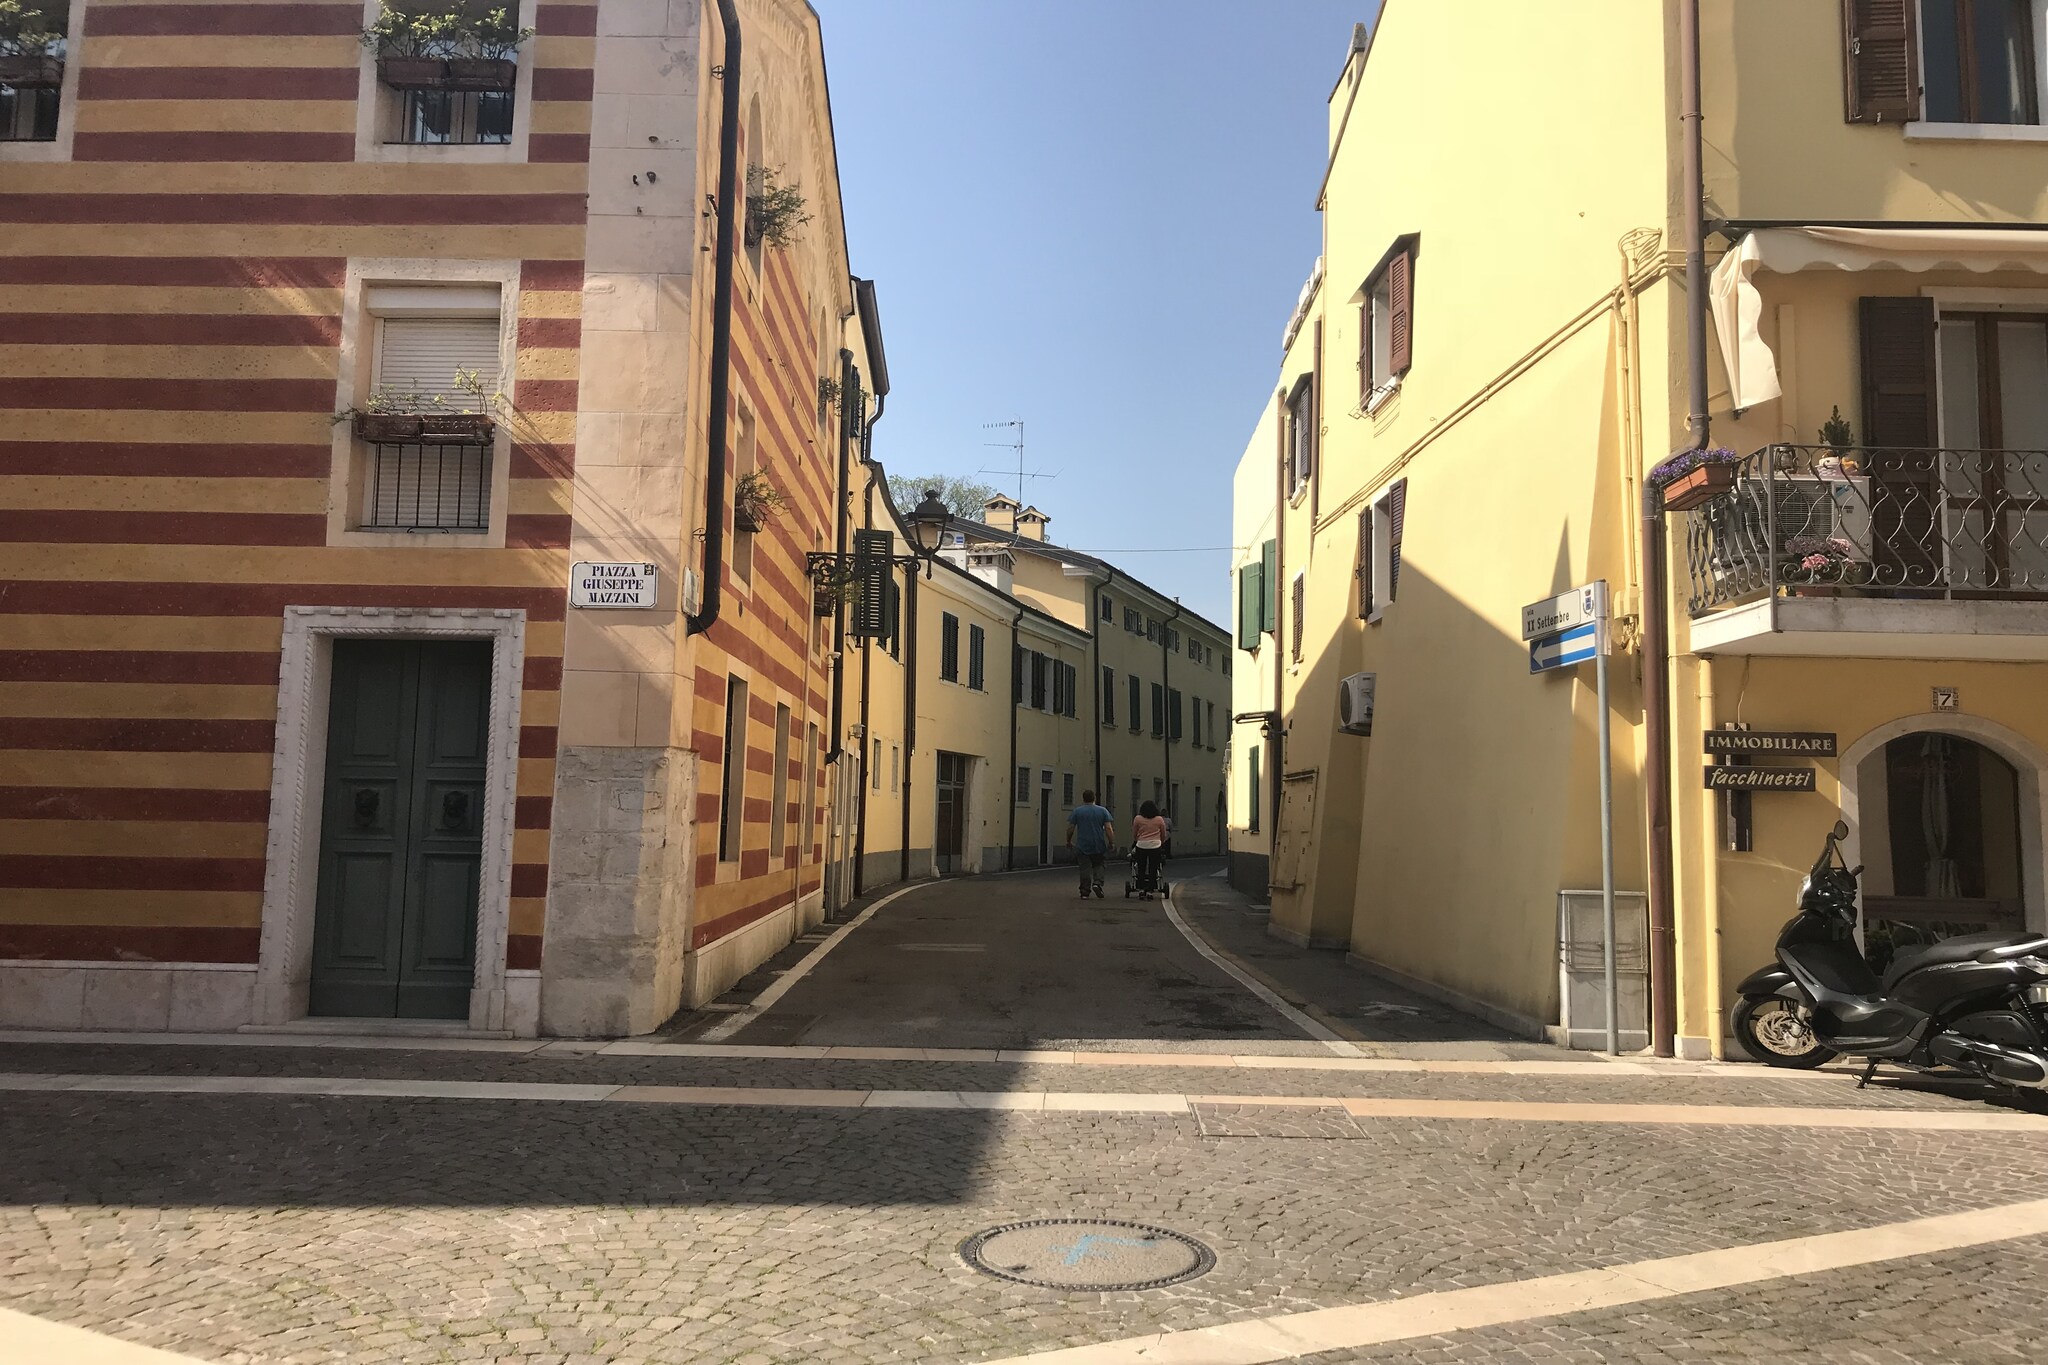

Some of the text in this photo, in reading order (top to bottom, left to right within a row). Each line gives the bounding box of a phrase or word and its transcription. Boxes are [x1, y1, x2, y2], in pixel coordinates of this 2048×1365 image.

[592, 566, 637, 577] PIAZZA
[583, 579, 644, 590] GIUSEPPE
[589, 592, 639, 604] MAZZINI
[1527, 610, 1570, 633] XX Settembre
[1939, 693, 1952, 706] 7
[1708, 736, 1833, 751] IMMOBILIARE
